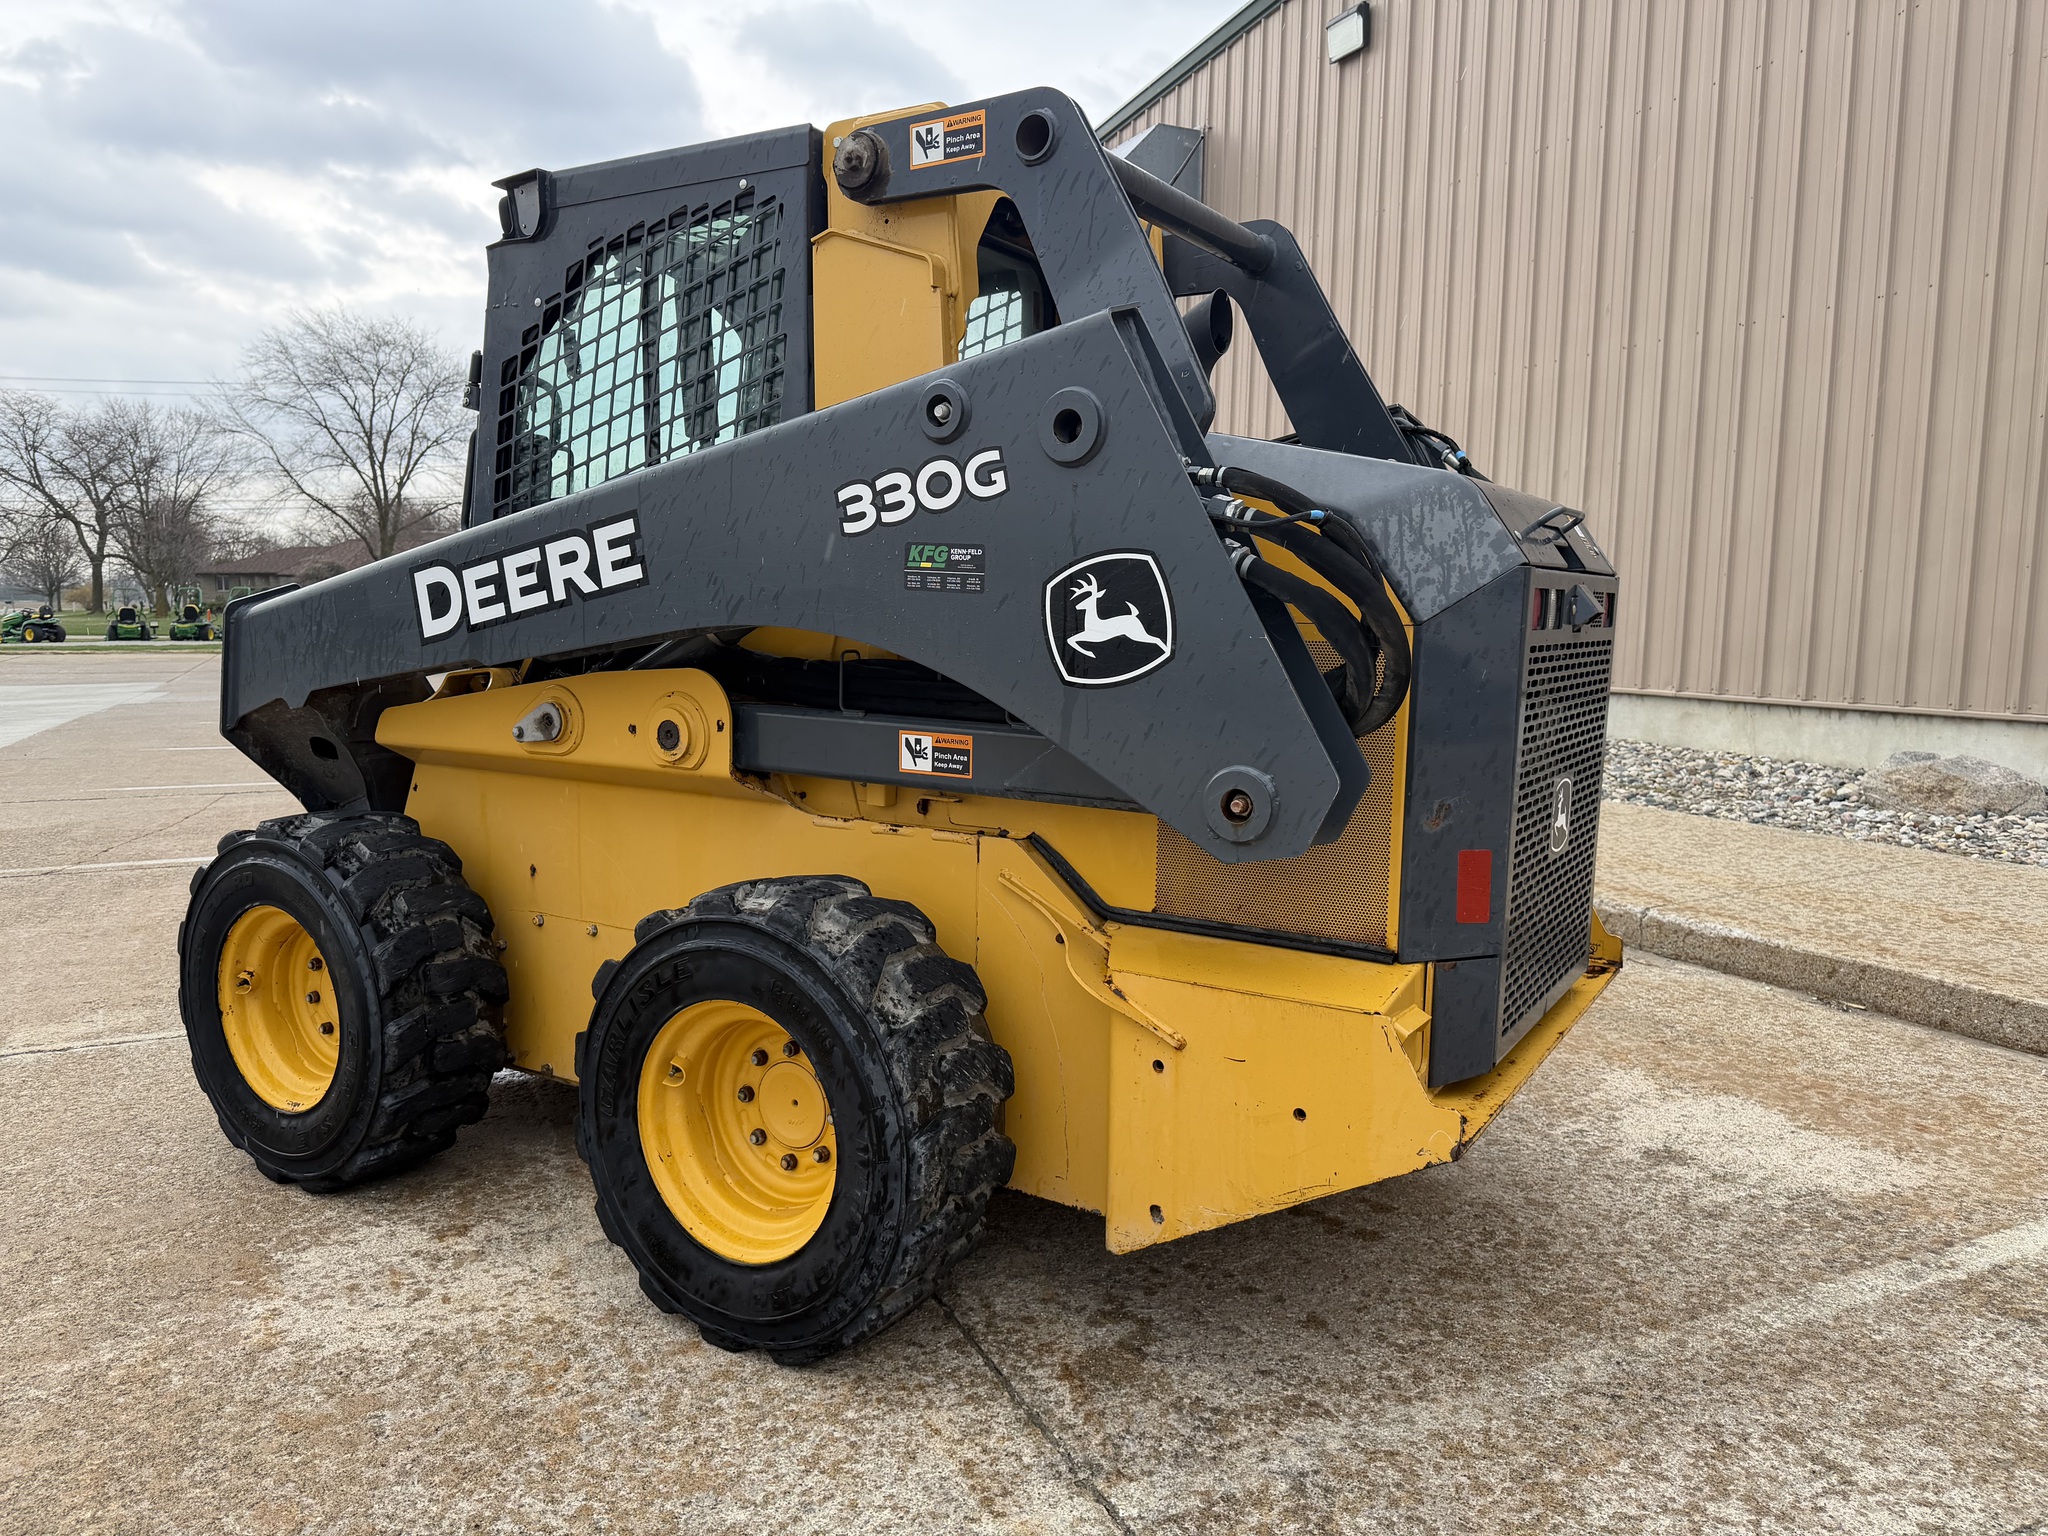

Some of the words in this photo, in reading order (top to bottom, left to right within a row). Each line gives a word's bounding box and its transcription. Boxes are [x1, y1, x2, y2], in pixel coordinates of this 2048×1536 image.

[953, 115, 981, 125] WARNING
[946, 135, 965, 144] Pinch
[837, 450, 1007, 534] 330G
[908, 545, 949, 562] KFG
[413, 518, 643, 638] DEERE
[934, 752, 952, 760] Pinch
[601, 957, 692, 1117] CARLISLE
